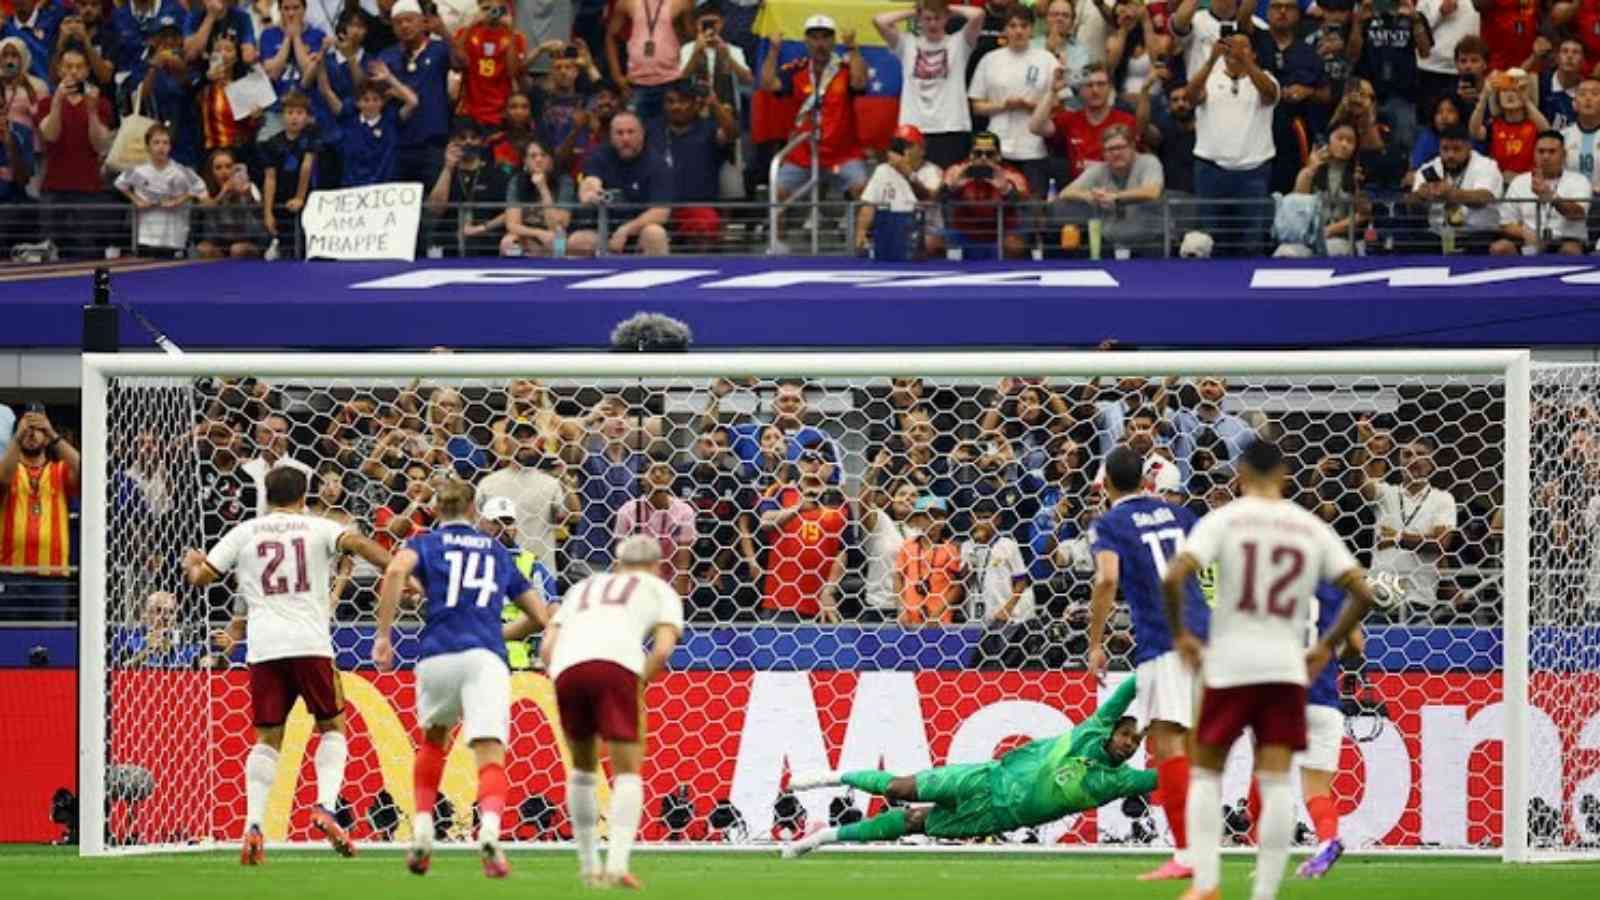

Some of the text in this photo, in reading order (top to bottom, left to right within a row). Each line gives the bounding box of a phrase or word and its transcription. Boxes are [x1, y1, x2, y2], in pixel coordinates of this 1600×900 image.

[479, 58, 497, 77] 19
[318, 187, 416, 211] MEXICO
[322, 211, 397, 230] AMA A
[347, 269, 1121, 290] FIFA
[257, 537, 310, 596] 21
[445, 550, 499, 608] 14
[1236, 542, 1305, 620] 12
[577, 575, 640, 612] 10
